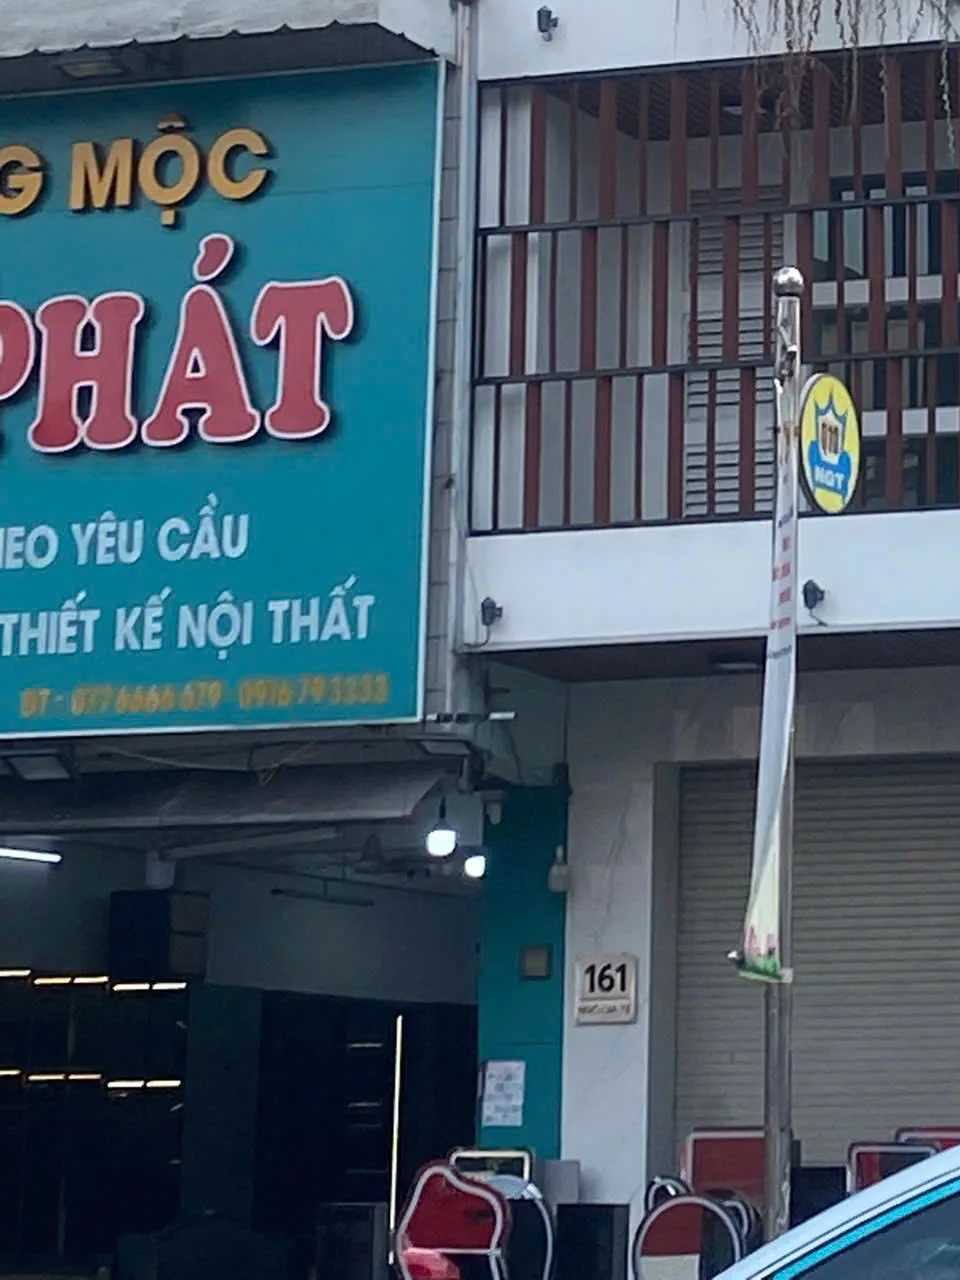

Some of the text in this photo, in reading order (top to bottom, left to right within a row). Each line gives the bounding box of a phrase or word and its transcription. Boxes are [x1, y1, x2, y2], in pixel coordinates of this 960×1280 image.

[69, 112, 268, 225] MỘC
[71, 510, 144, 565] YÊU
[157, 492, 249, 561] CẦU
[0, 574, 375, 660] THIẾT KẾ NỘI THẤT
[584, 963, 628, 993] 161
